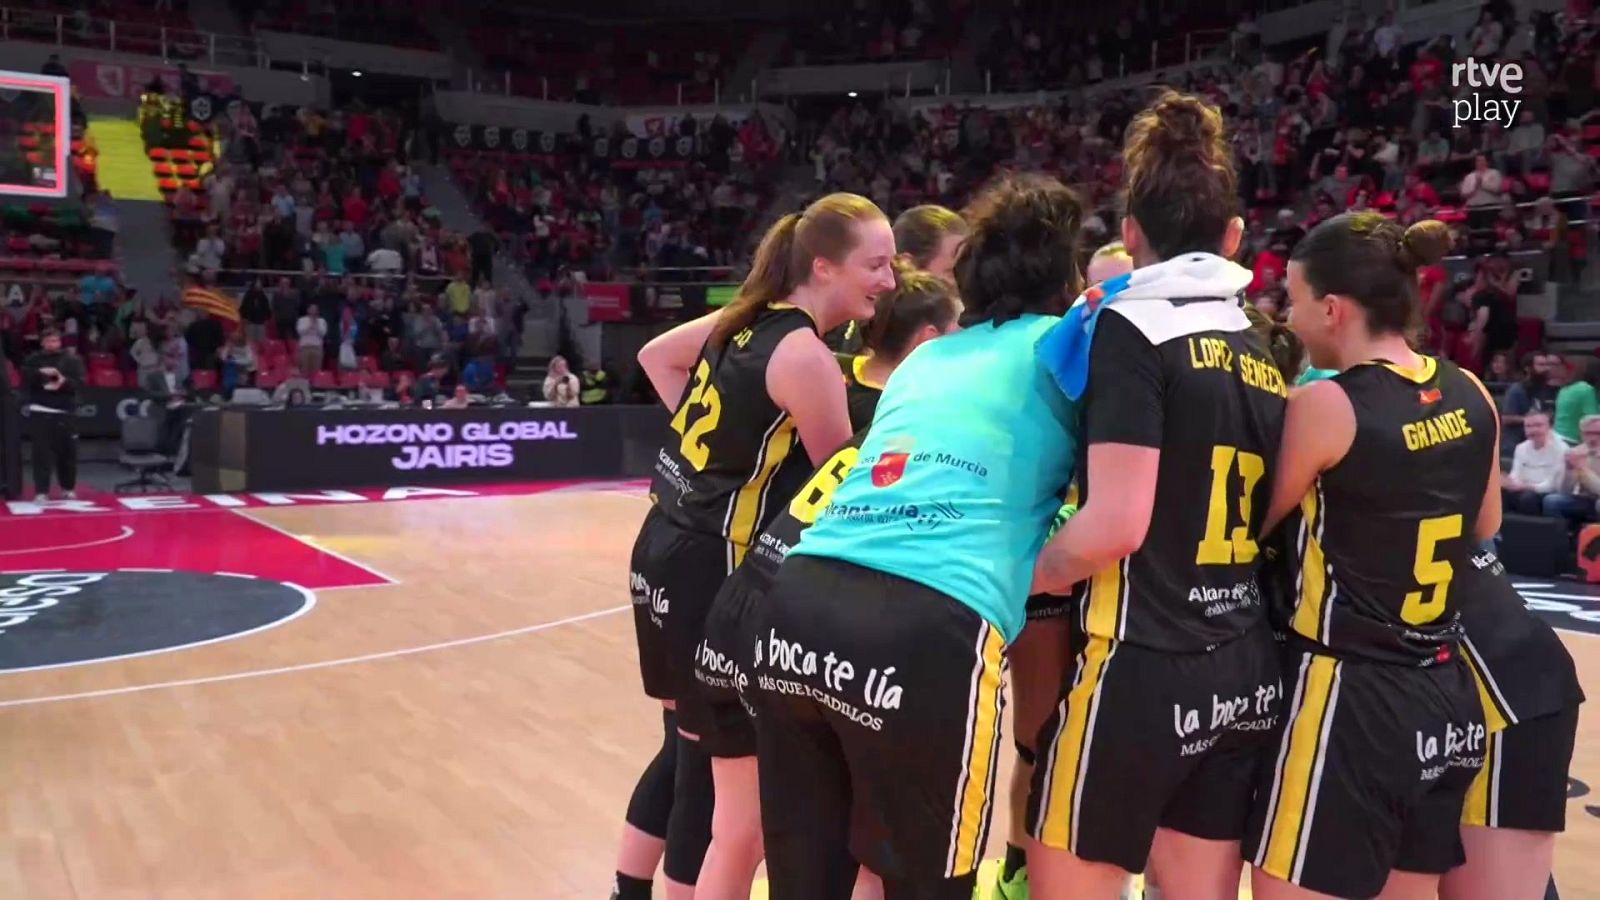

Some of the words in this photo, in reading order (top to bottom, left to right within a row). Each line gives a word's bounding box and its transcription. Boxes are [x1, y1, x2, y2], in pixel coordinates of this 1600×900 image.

[317, 423, 453, 445] HOZONO
[461, 421, 578, 442] GLOBAL
[1402, 408, 1472, 451] GRANDE
[392, 444, 514, 469] JAIRIS
[913, 452, 931, 463] de
[935, 452, 988, 479] Murcia
[9, 485, 481, 515] REINA
[1196, 445, 1265, 565] 13
[1400, 514, 1463, 626] 5
[769, 627, 818, 676] boca
[823, 651, 855, 692] te
[864, 666, 904, 710] lía
[775, 679, 803, 696] QUE
[803, 683, 884, 732] BCADILLOS
[1174, 703, 1200, 738] la
[1416, 730, 1439, 763] la
